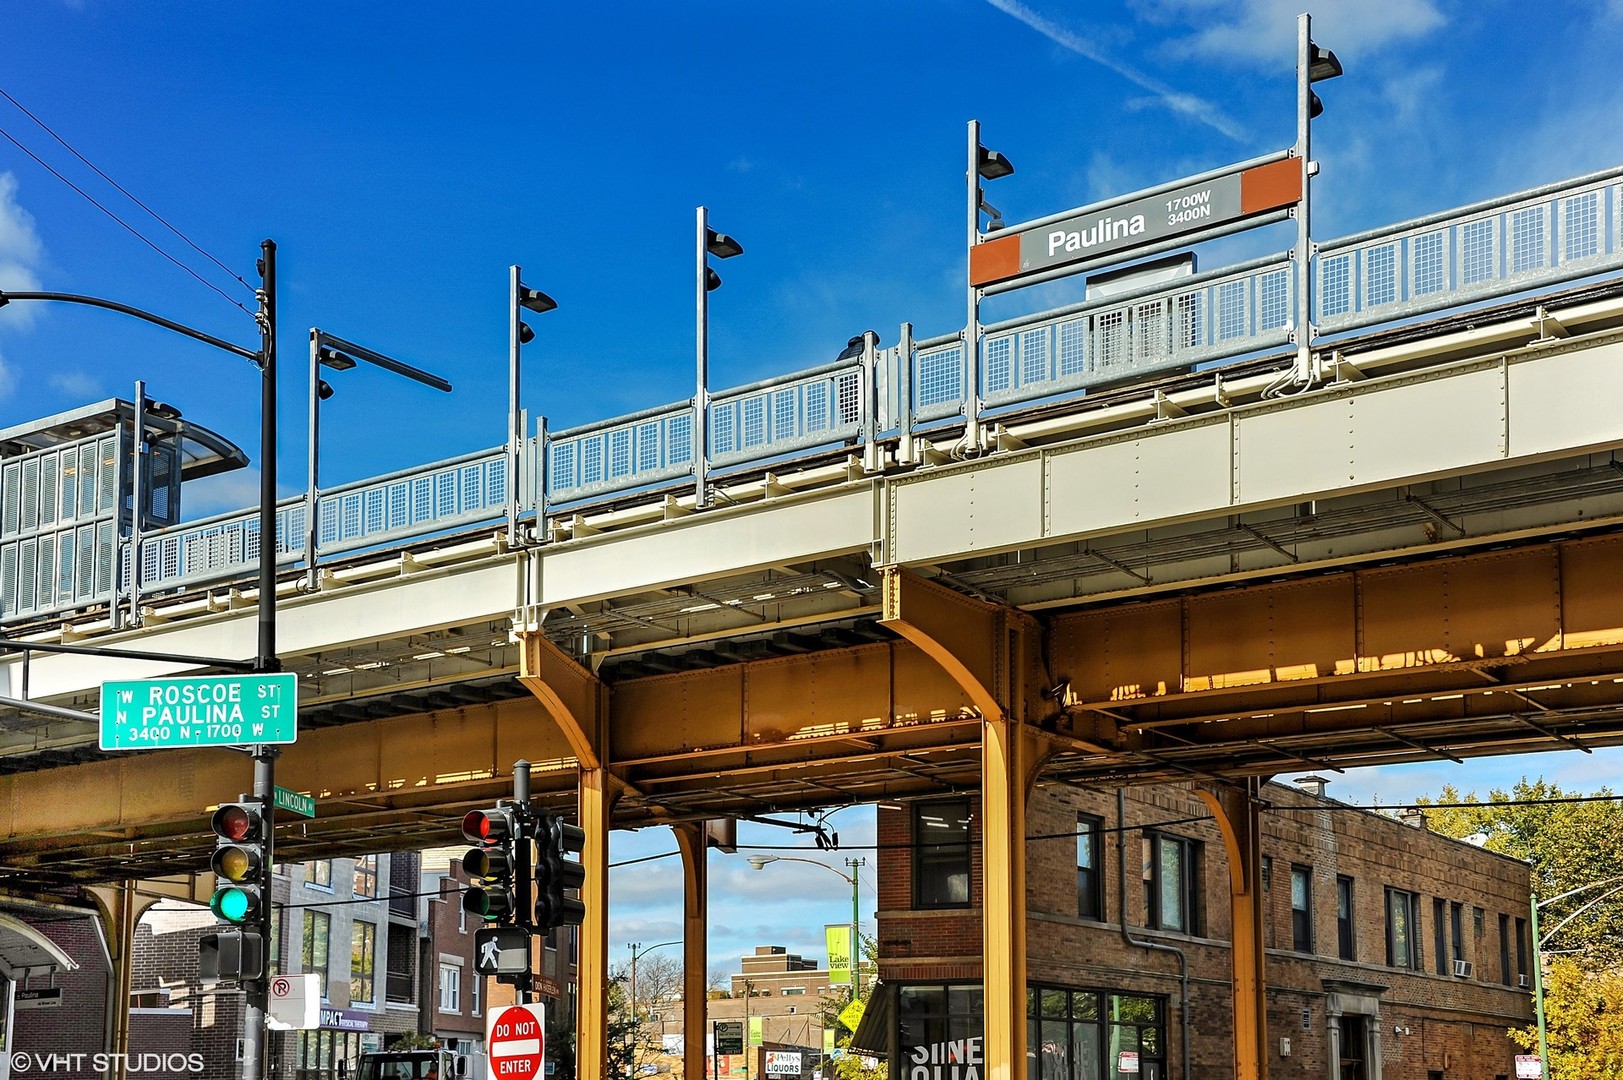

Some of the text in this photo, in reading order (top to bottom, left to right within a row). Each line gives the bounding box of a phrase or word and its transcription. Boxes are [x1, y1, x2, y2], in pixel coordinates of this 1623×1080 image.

[1166, 190, 1211, 212] 1700W
[1168, 204, 1211, 226] 3400N
[1048, 214, 1146, 256] Paulina
[122, 684, 276, 706] W ROSCOE ST
[117, 704, 280, 726] N PAULINA ST
[128, 726, 170, 741] 3400
[180, 726, 190, 739] N
[206, 724, 242, 738] 1700
[252, 723, 264, 736] W
[278, 790, 307, 812] LINCOLN
[321, 1010, 342, 1026] MPACT
[496, 1022, 535, 1037] DO NOT
[500, 1060, 531, 1074] ENTER
[767, 1064, 799, 1073] LIQUORS
[775, 1053, 800, 1064] Pellys
